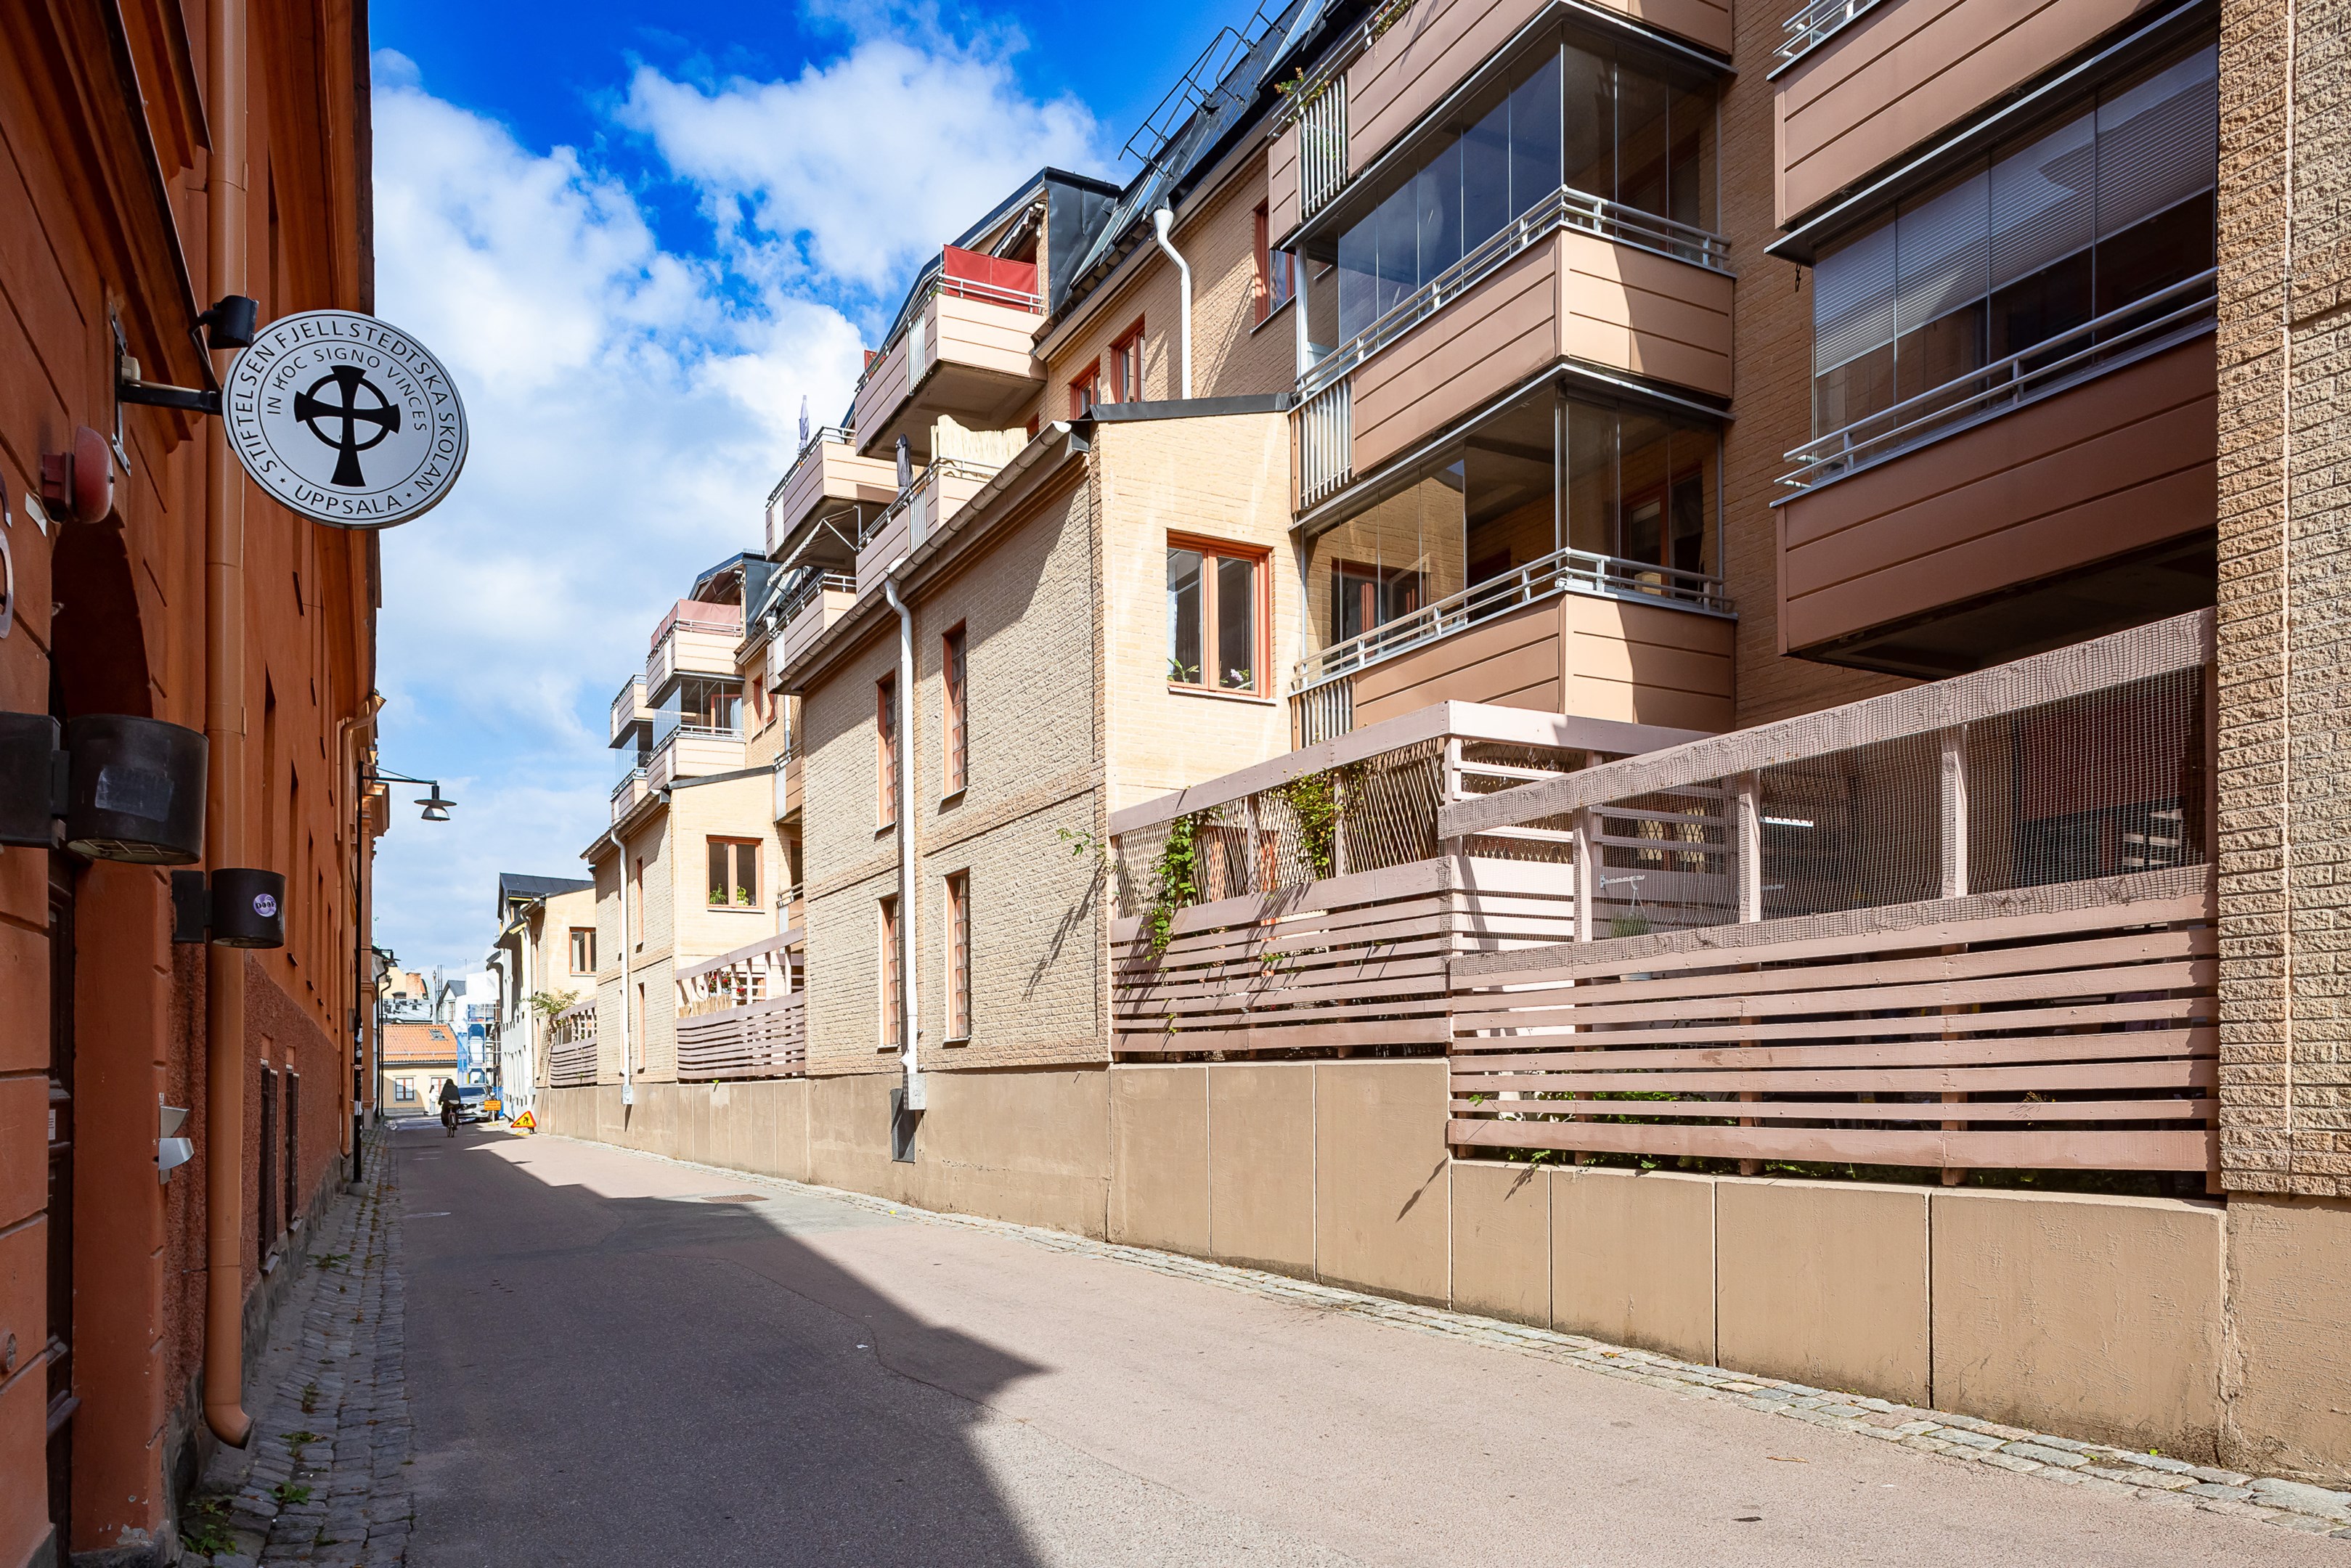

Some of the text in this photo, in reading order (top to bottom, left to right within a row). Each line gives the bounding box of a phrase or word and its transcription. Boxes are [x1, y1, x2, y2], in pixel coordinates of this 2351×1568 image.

[236, 345, 277, 473] STIFTELSEN
[415, 412, 455, 492] SKOLAN
[267, 348, 427, 431] IN HOC SIGNO VINCES
[295, 485, 402, 515] UPPSALA
